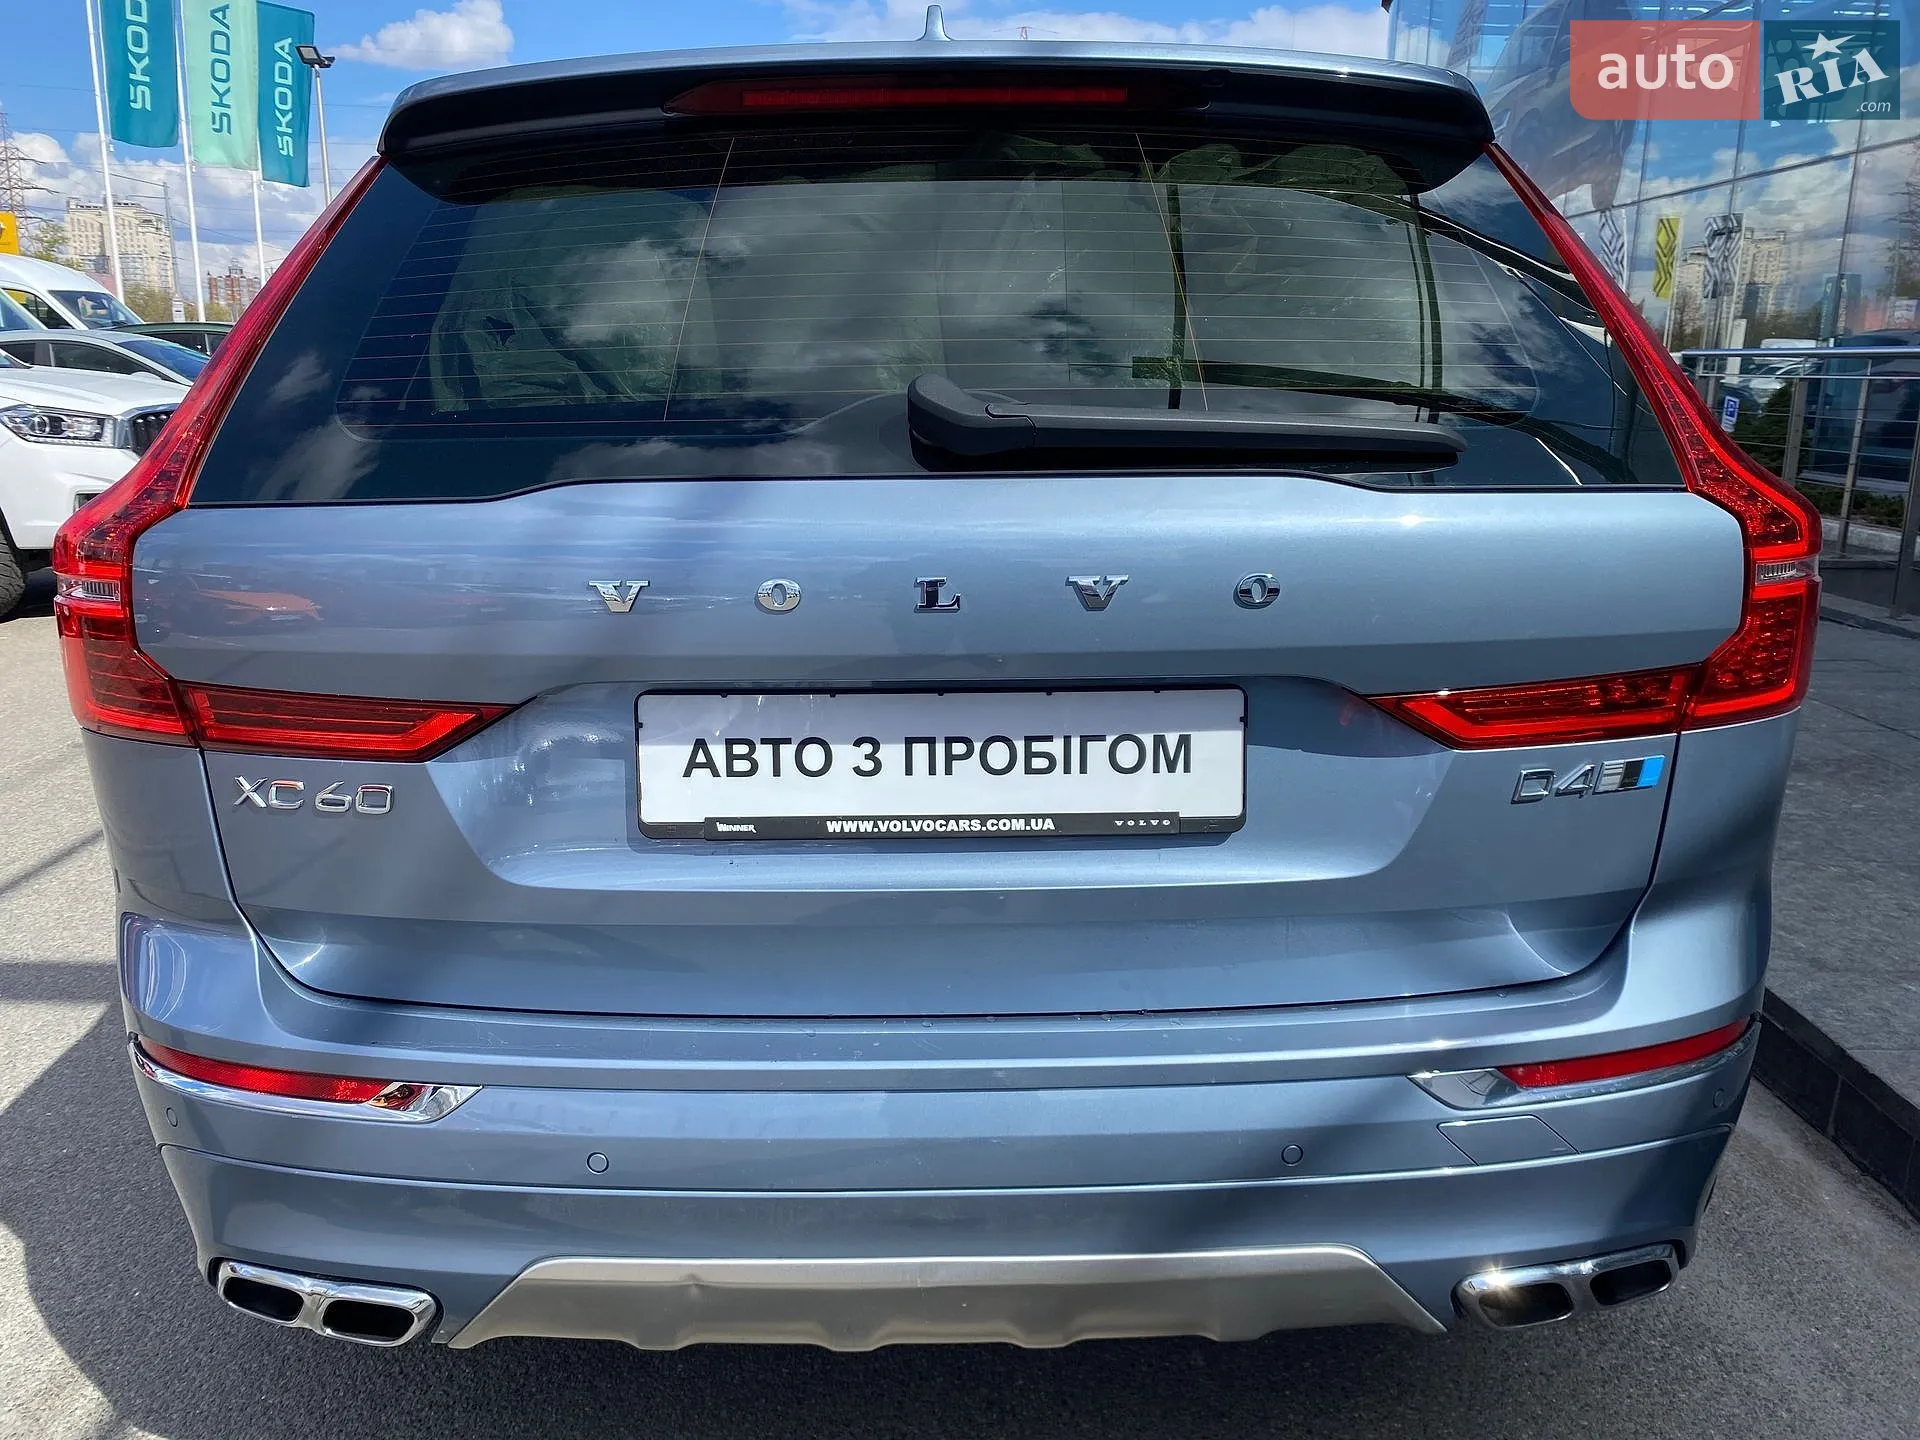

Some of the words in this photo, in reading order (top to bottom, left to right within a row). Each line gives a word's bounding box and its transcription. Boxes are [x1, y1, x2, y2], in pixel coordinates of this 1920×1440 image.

[589, 572, 1281, 614] VOLVO
[682, 736, 834, 778] АВТО
[904, 733, 1192, 776] ПРОБІГОМ
[826, 818, 1055, 833] WWW.VOLVOCARS.COM.UA
[1114, 819, 1171, 827] VOLVO
